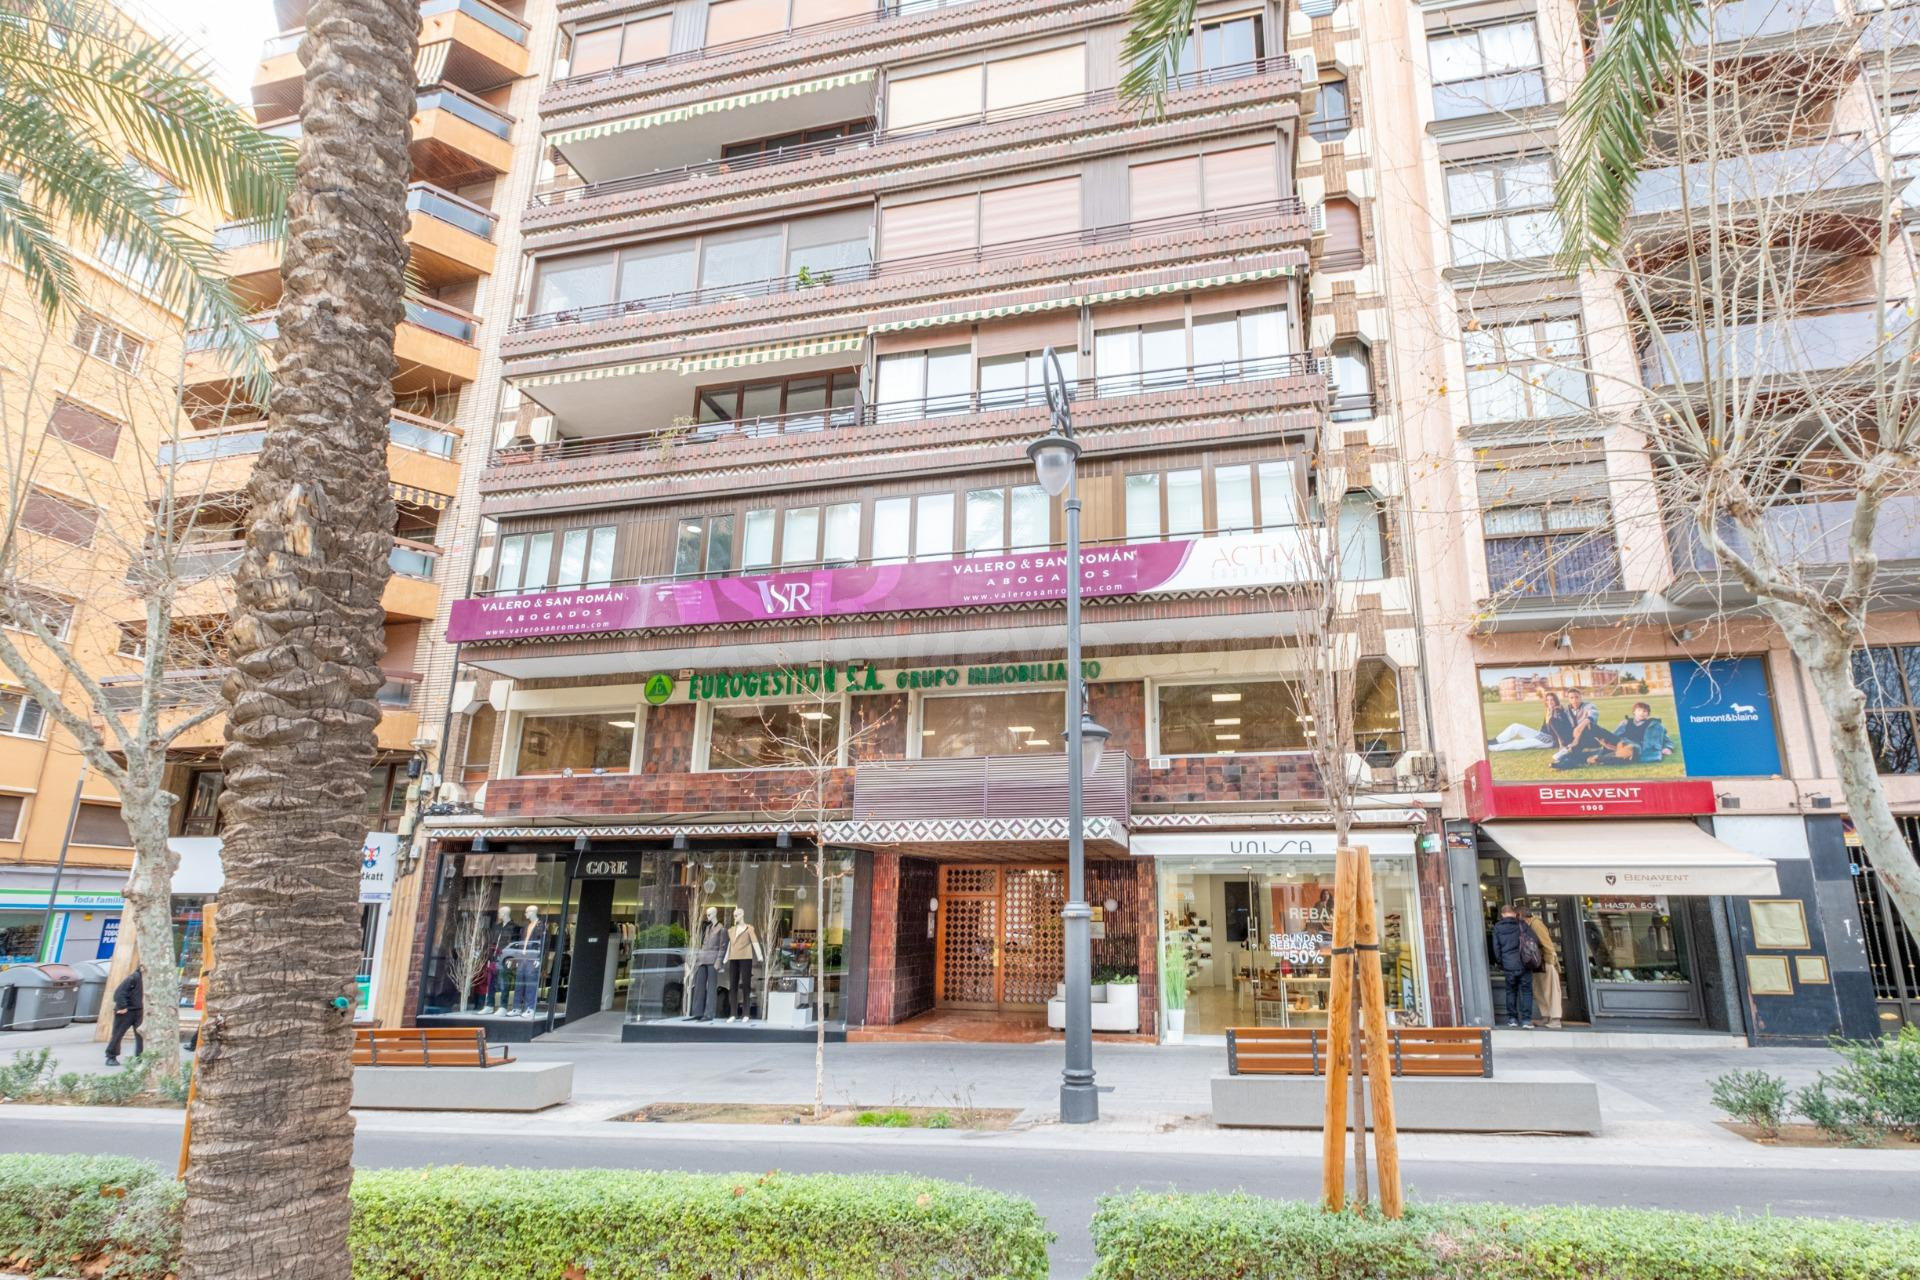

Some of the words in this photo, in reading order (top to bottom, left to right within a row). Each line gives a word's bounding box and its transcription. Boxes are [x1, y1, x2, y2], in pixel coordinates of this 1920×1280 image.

[953, 560, 1017, 576] VALERO
[1020, 559, 1031, 570] &
[1035, 556, 1068, 568] SAN
[1079, 549, 1135, 565] ROMÁN
[986, 570, 1111, 587] ABOGAOS
[963, 583, 1123, 602] www.valerosanroan.com
[481, 599, 532, 612] VALERO
[534, 598, 543, 609] &
[545, 597, 573, 608] SAN
[576, 591, 624, 605] ROMÁN
[505, 608, 603, 623] ABOGADOS
[485, 620, 610, 637] www.valerosanroman.com
[689, 666, 837, 700] EUROGESTION
[846, 663, 885, 692] S.A.
[896, 668, 960, 689] GRUPO
[968, 660, 1101, 685] INMOBILIAIO
[1690, 714, 1759, 723] harmont&blaine
[1539, 787, 1641, 799] BENAVENT
[586, 861, 628, 875] GORE
[1623, 874, 1689, 882] BENAVENT
[73, 896, 95, 904] Toda
[1269, 934, 1323, 943] SEGUNDAS
[1270, 941, 1315, 950] REBAJAS
[1289, 950, 1324, 964] 50%
